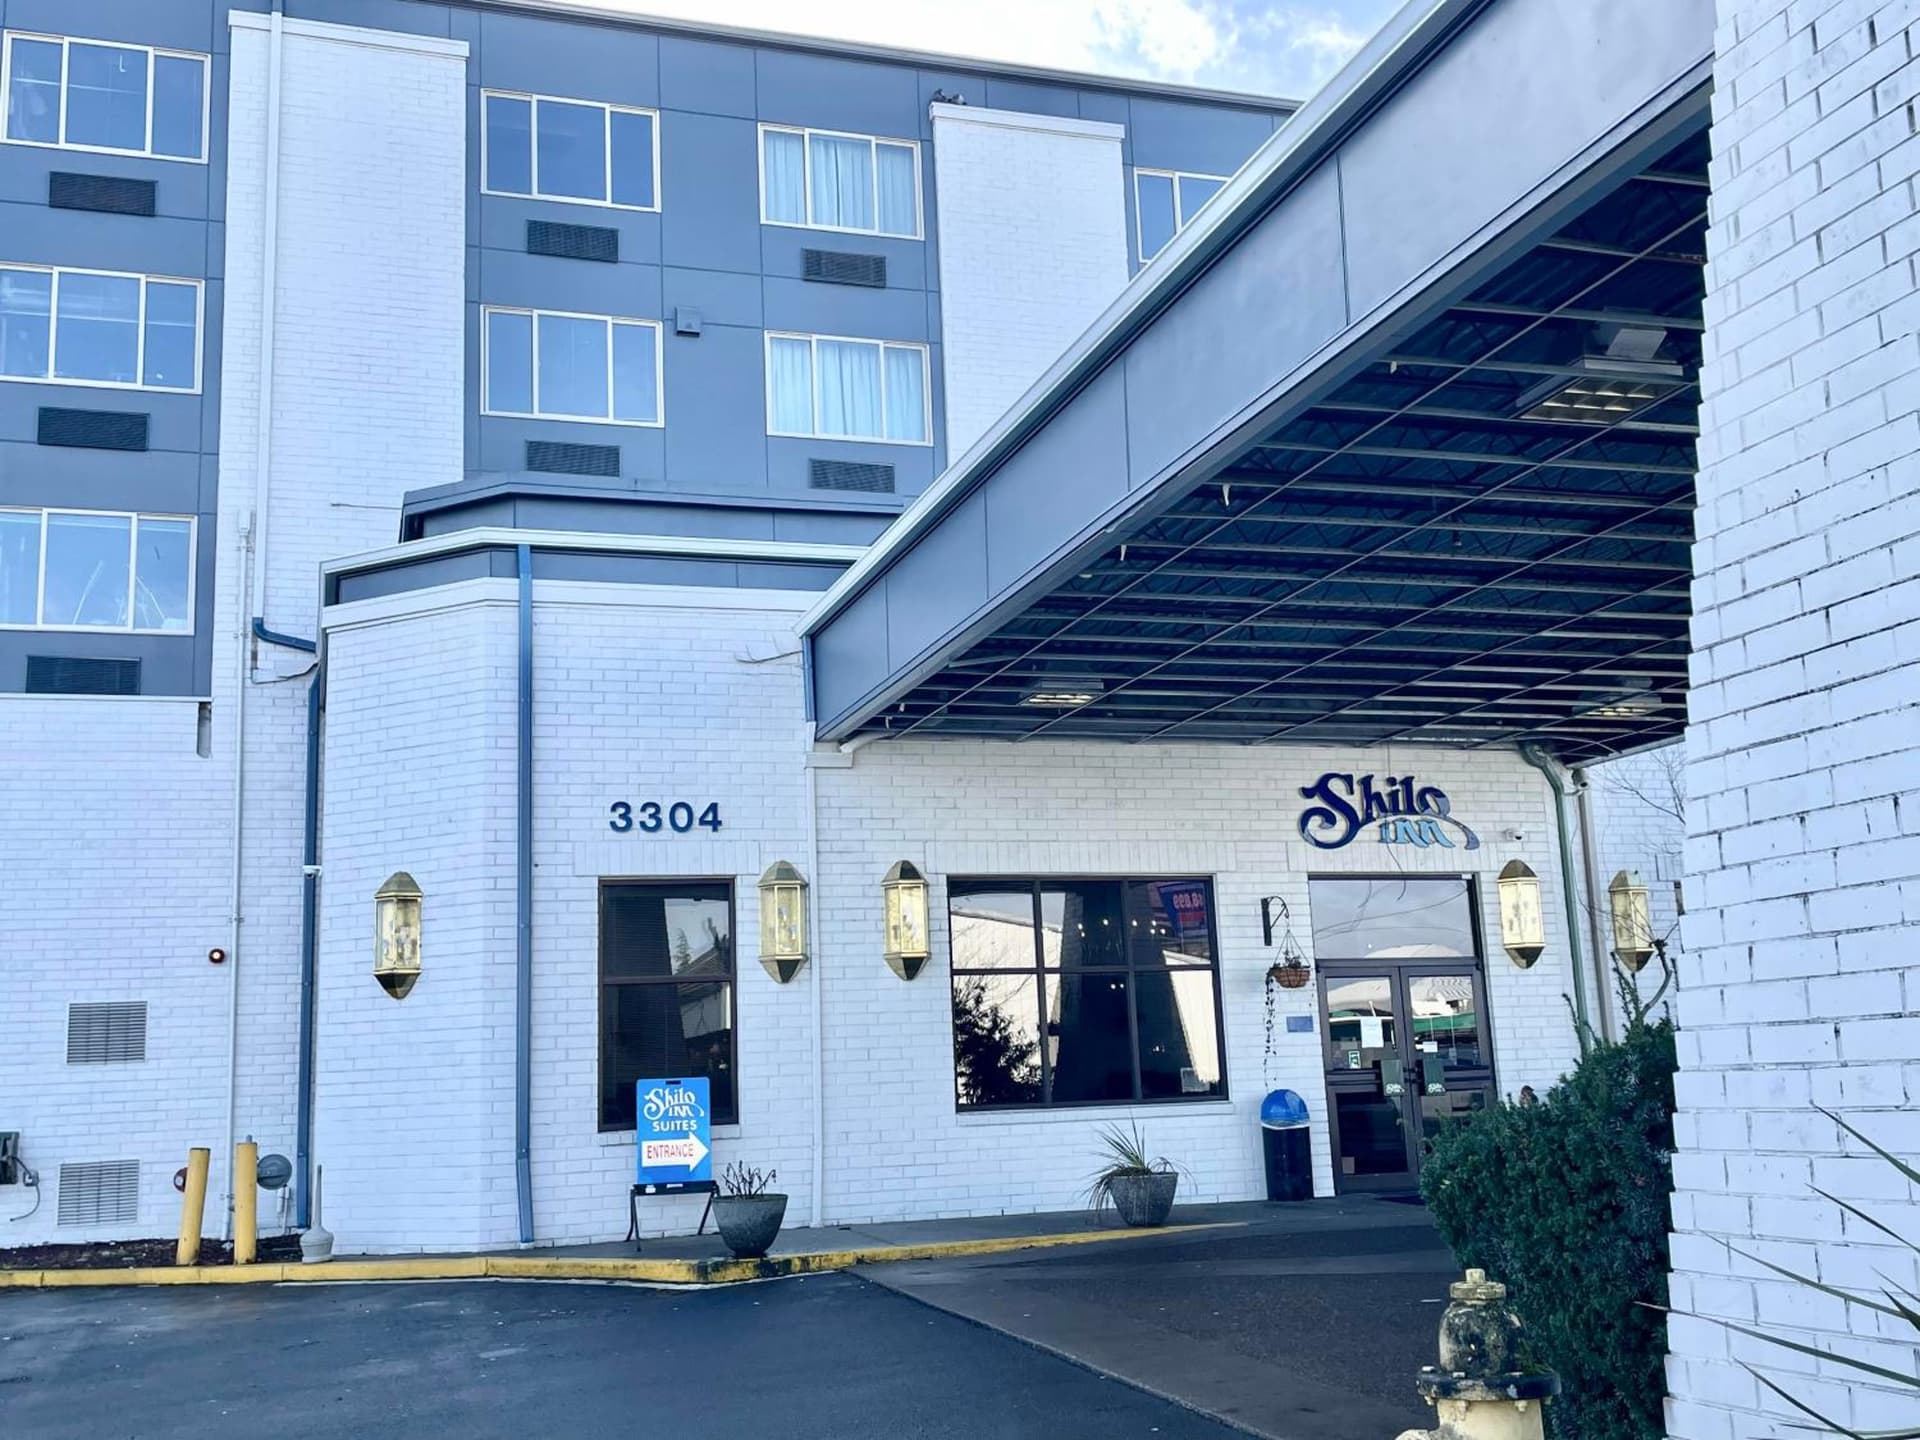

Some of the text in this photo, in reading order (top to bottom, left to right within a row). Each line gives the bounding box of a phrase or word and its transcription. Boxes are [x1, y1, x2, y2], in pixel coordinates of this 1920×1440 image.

[609, 801, 723, 833] 3304
[1299, 772, 1452, 850] Shilo
[643, 1087, 697, 1121] Shilo
[652, 1119, 698, 1133] SUITES
[646, 1143, 695, 1160] ENTRANCE
